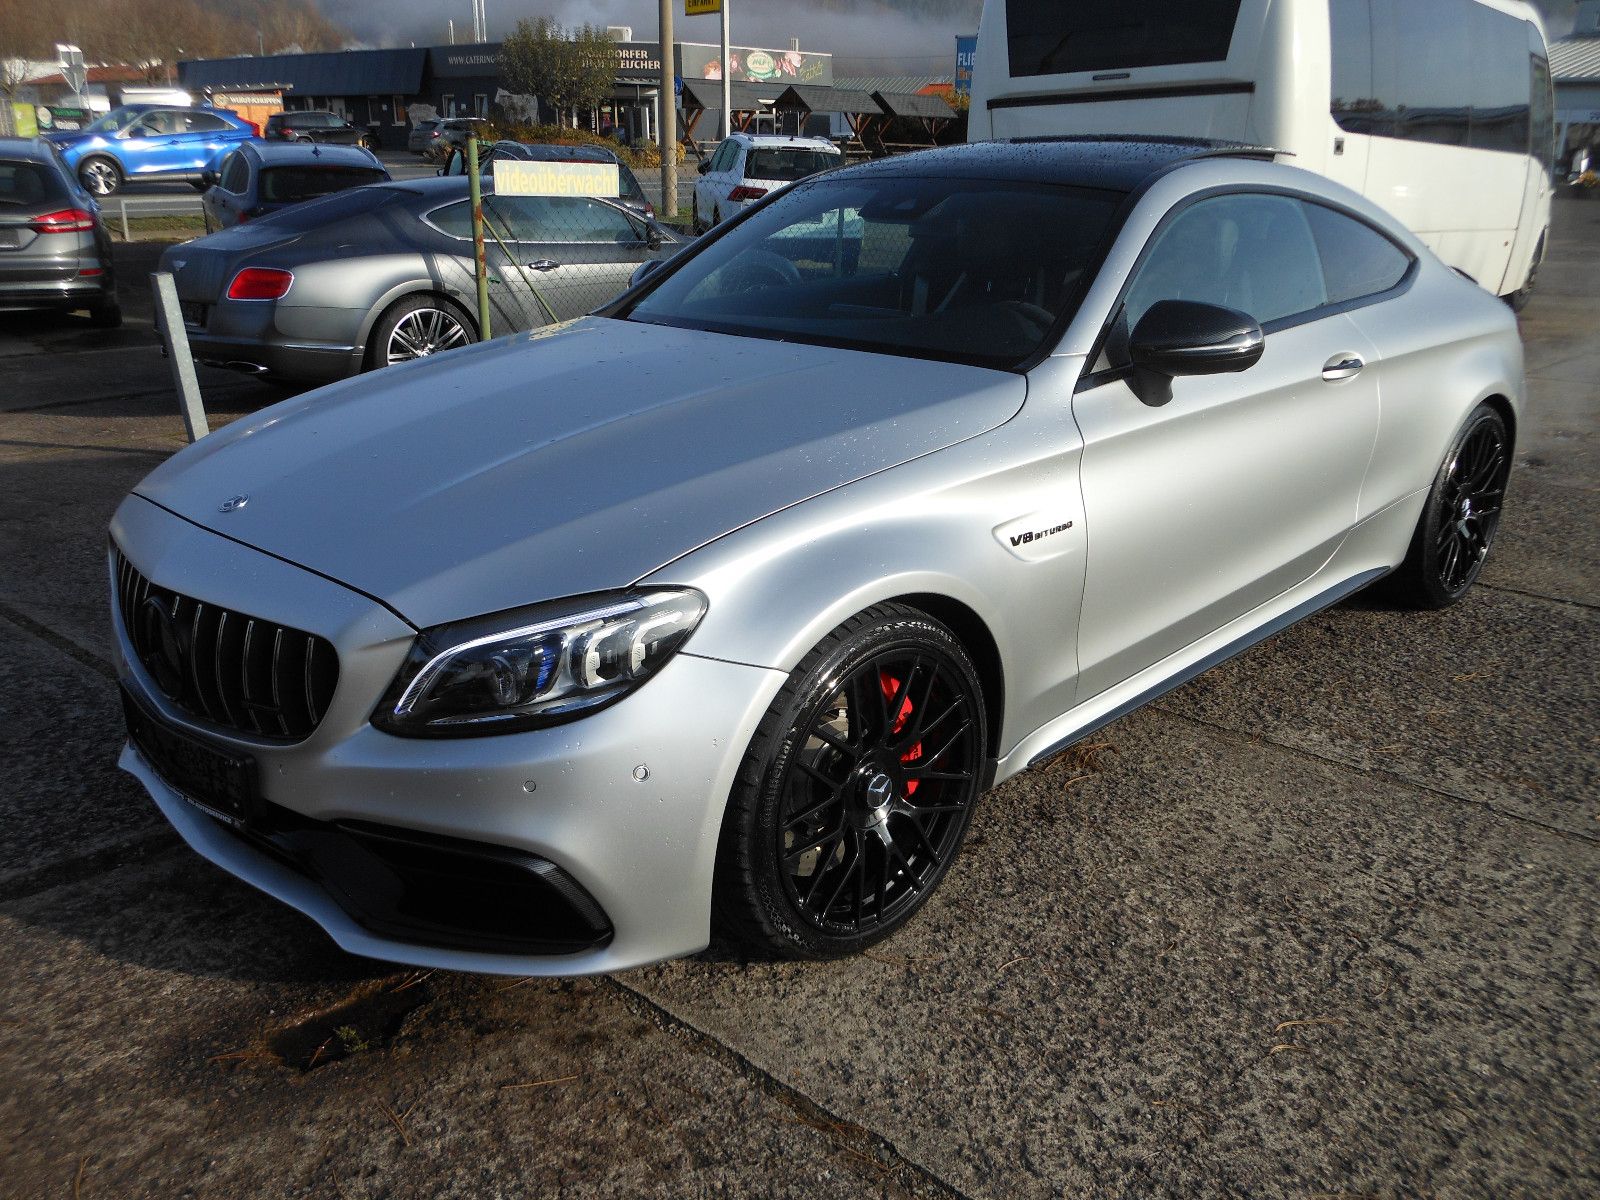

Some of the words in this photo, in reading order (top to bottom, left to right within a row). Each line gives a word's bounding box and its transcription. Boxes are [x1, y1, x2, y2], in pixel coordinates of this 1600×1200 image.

[957, 52, 976, 66] FLIE
[1010, 532, 1034, 547] V8
[1034, 521, 1073, 541] BITURBO
